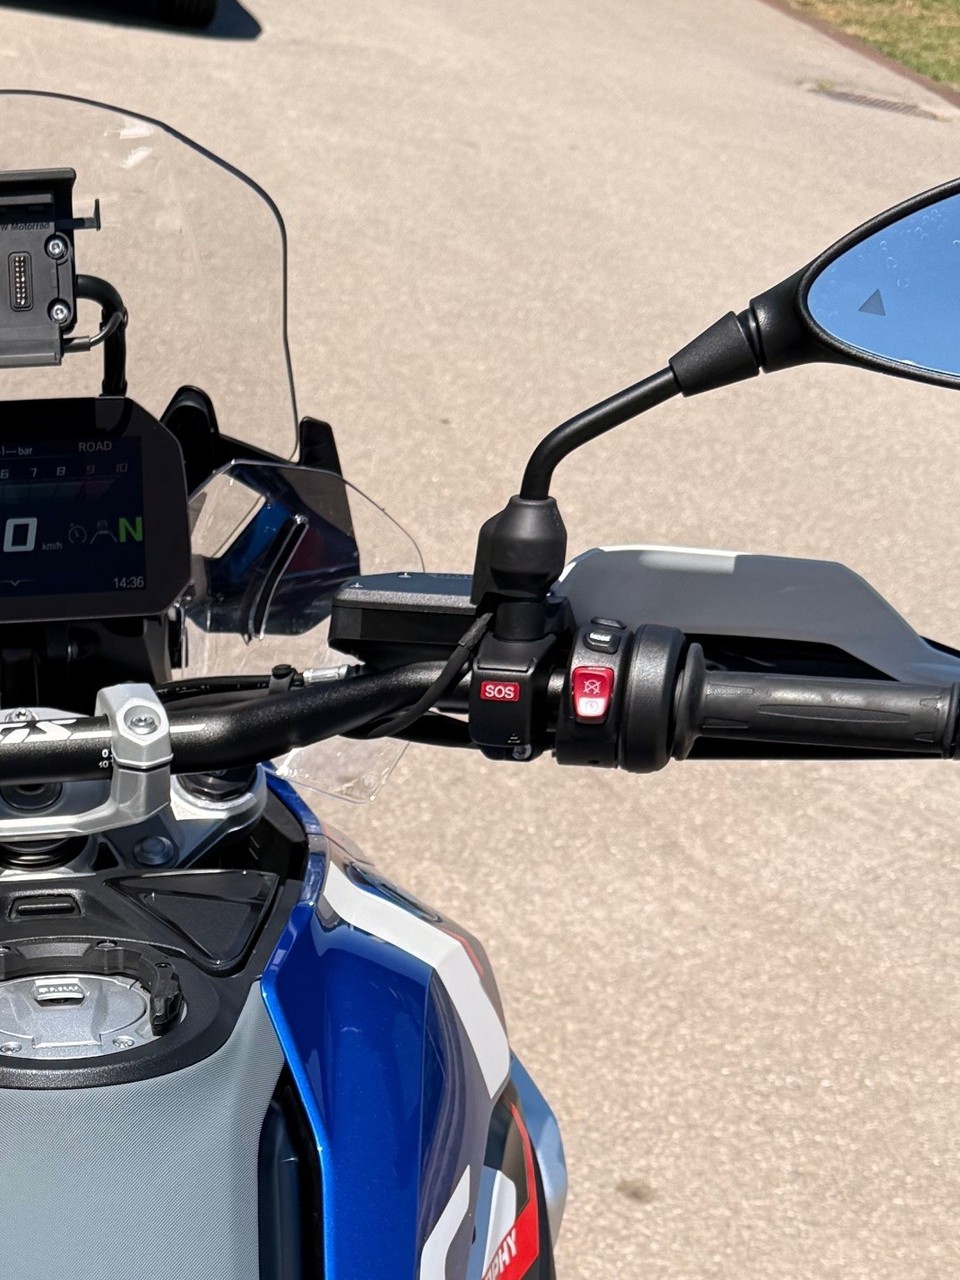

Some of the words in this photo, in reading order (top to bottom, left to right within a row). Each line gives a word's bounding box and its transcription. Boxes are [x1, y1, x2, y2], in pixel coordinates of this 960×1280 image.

[11, 222, 49, 231] Motorrad
[18, 446, 33, 456] bar
[78, 440, 113, 453] ROAD
[0, 469, 10, 479] 6
[29, 468, 38, 478] 7
[56, 466, 66, 476] 8
[86, 465, 95, 475] 9
[116, 463, 128, 473] 10
[3, 517, 38, 553] 0
[42, 541, 63, 551] km/h
[118, 516, 143, 542] N
[113, 576, 145, 589] 14:36
[485, 685, 515, 699] SOS
[101, 748, 109, 758] 0
[98, 760, 109, 769] 10
